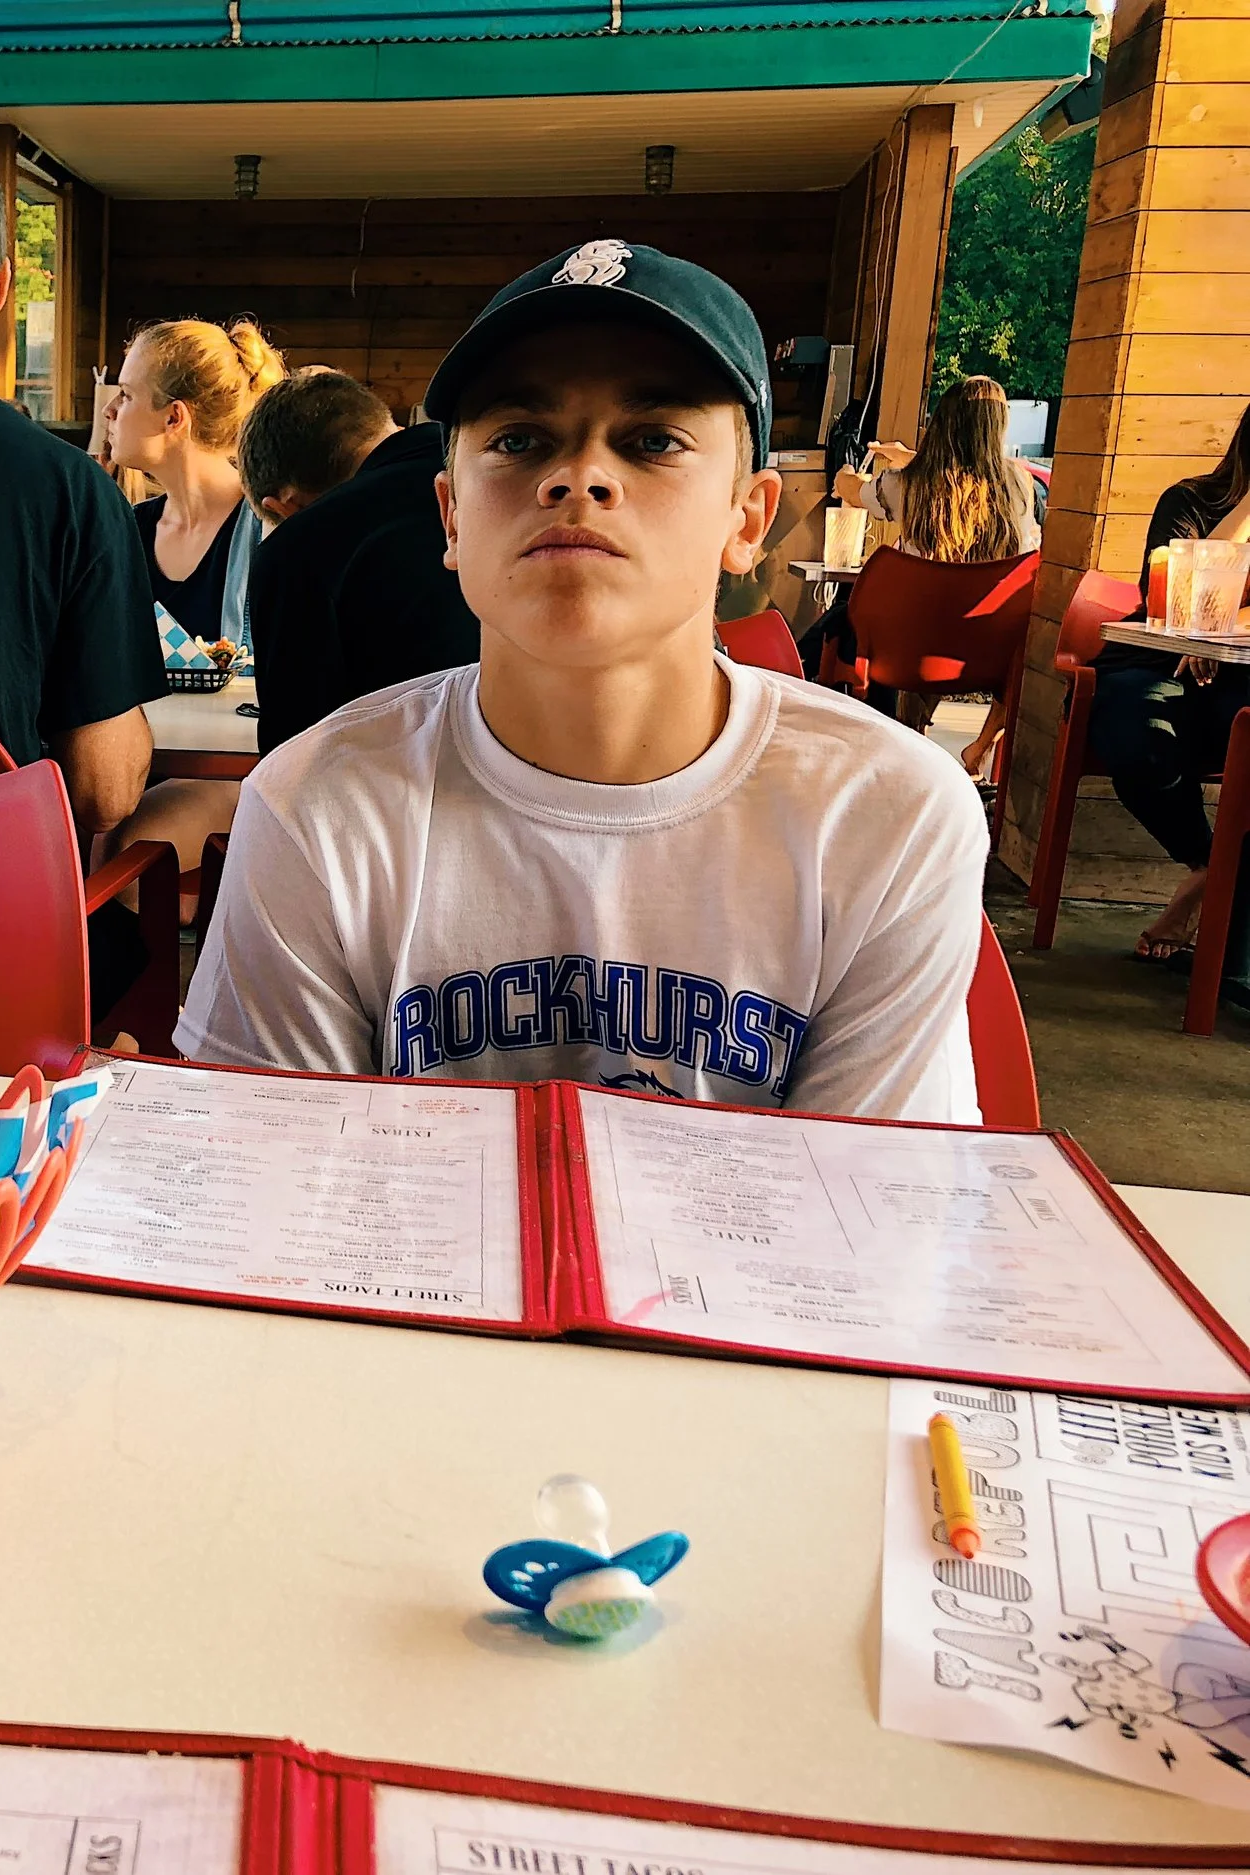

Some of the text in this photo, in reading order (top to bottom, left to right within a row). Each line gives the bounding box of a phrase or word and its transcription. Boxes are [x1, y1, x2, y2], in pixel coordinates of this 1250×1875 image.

[390, 954, 808, 1100] ROCKHURST
[323, 1282, 464, 1303] STREET TACOS
[1182, 1438, 1235, 1481] KIDS
[932, 1557, 1042, 1702] TACO
[467, 1839, 589, 1875] STREET
